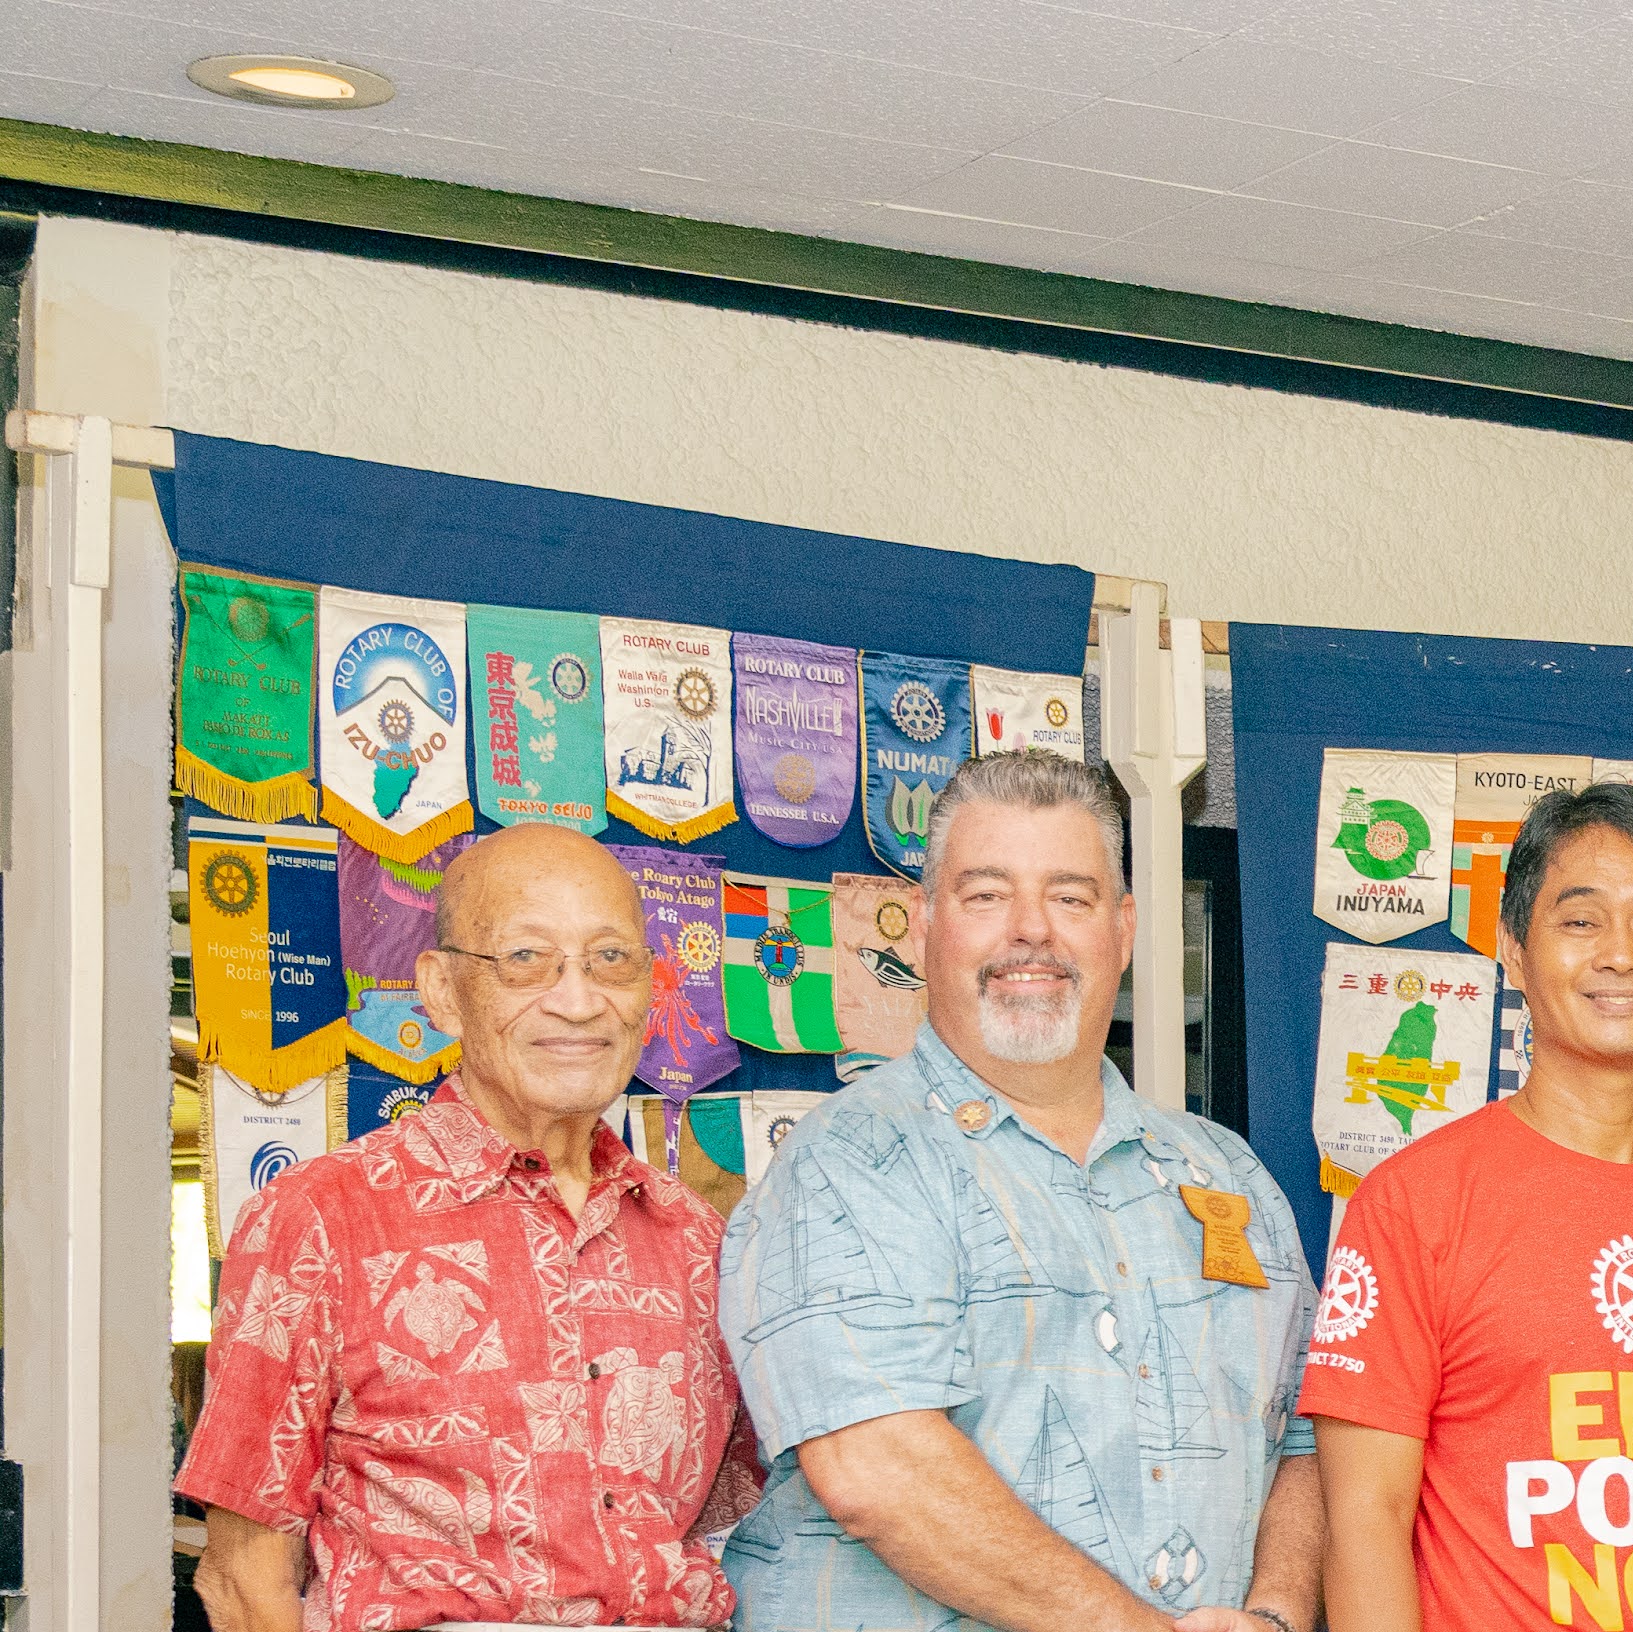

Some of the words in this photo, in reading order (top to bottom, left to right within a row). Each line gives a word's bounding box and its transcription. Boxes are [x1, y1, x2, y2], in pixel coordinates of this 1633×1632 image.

[622, 634, 672, 652] ROTARY
[675, 640, 711, 657] CLUB
[335, 628, 394, 690] ROTARY
[402, 630, 448, 679] CLUB
[436, 687, 455, 720] OF
[744, 656, 802, 679] ROTARY
[805, 666, 846, 686] CLUB
[258, 675, 301, 696] CLUB
[485, 651, 523, 788] 東京成城
[745, 683, 843, 737] NASHVILLE
[342, 722, 448, 771] IZU-CHUO
[1032, 730, 1061, 743] ROTARY
[1063, 732, 1082, 746] CLUB
[1474, 771, 1577, 791] KYOTO-EAST
[415, 799, 443, 809] JAPAN
[497, 797, 549, 815] TOKYO
[552, 801, 593, 820] SEIJO
[751, 803, 808, 821] TENNESSEE
[812, 810, 840, 826] U.S.A.
[1355, 883, 1407, 898] JAPAN
[1335, 895, 1426, 916] INUYAMA
[249, 926, 290, 947] Seoul
[207, 941, 275, 963] Hoehyon
[278, 951, 305, 966] (Wise
[307, 953, 332, 968] Man)
[225, 963, 276, 987] Rotary
[280, 966, 315, 987] Club
[380, 979, 414, 989] ROTARY
[1338, 973, 1389, 995] 三重
[1429, 978, 1483, 1002] 中央
[240, 1008, 271, 1021] SINCE
[275, 1011, 300, 1024] 1996
[658, 1066, 693, 1084] Japan
[1353, 1144, 1375, 1154] CLUB
[1378, 1147, 1389, 1155] OF
